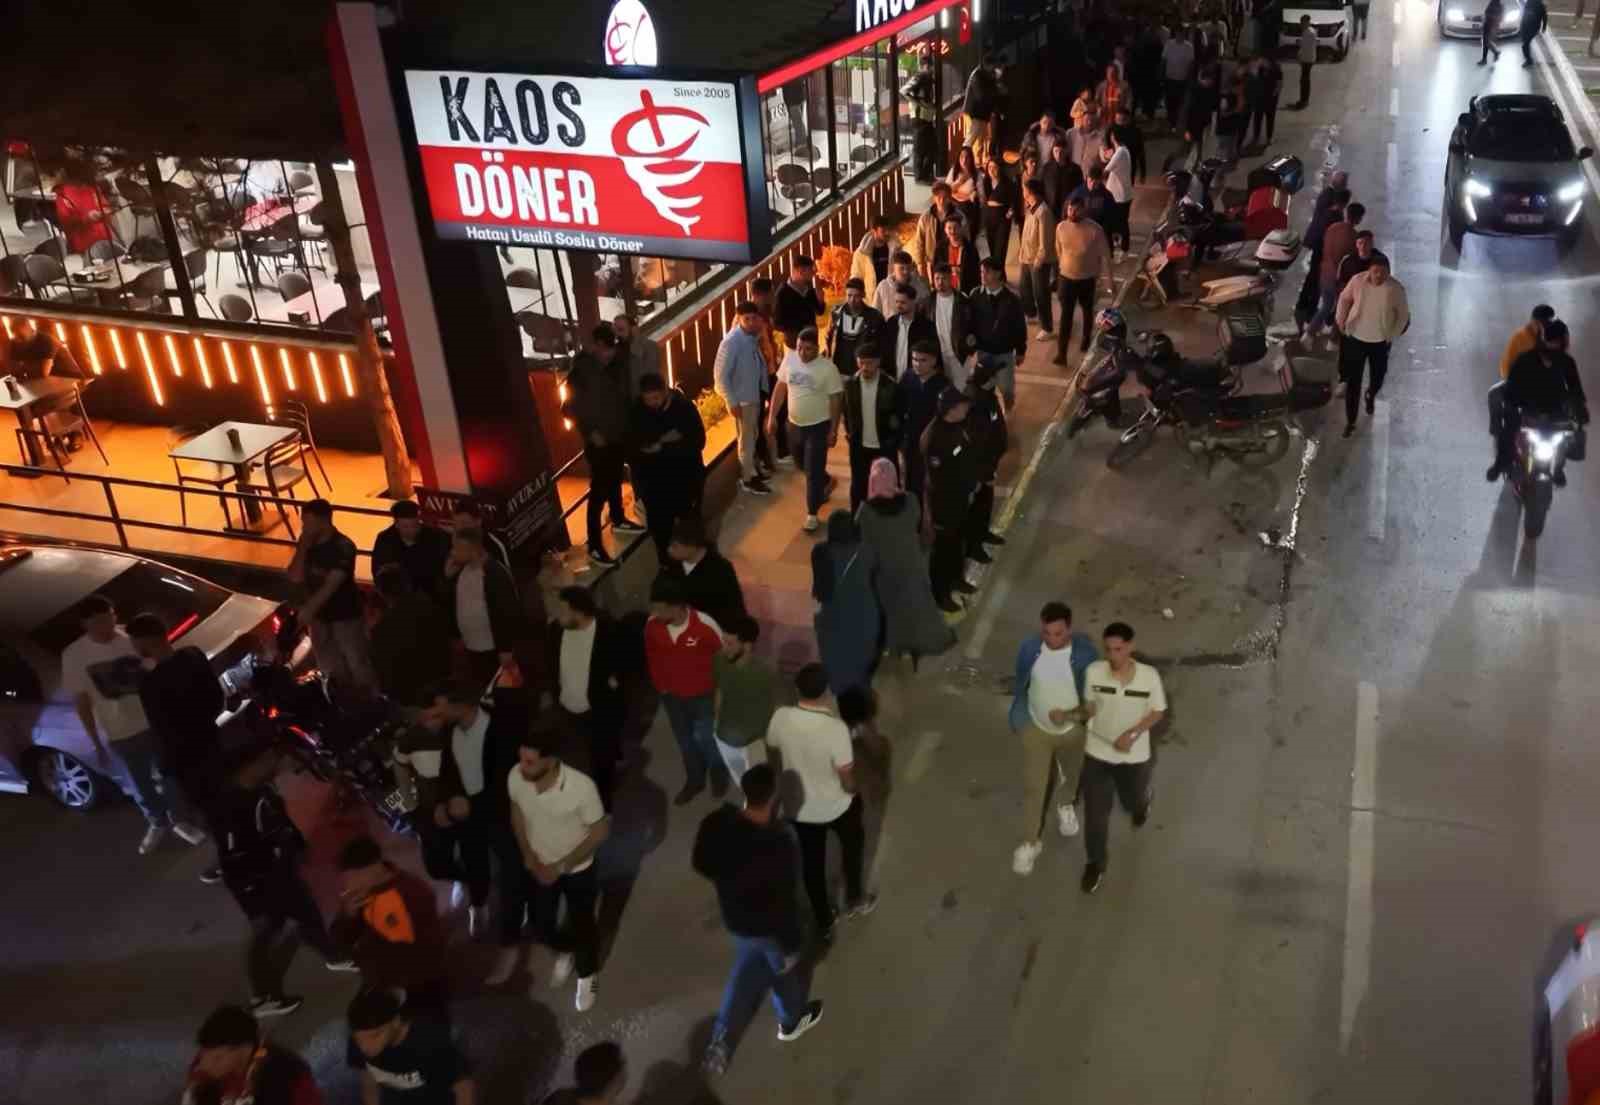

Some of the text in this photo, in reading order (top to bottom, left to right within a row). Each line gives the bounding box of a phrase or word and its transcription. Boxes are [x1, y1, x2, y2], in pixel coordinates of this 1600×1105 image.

[439, 75, 586, 147] KAOS
[673, 87, 701, 97] Since
[453, 150, 599, 225] DÖNER
[465, 225, 643, 252] Hatay Usulü Soslu Döner
